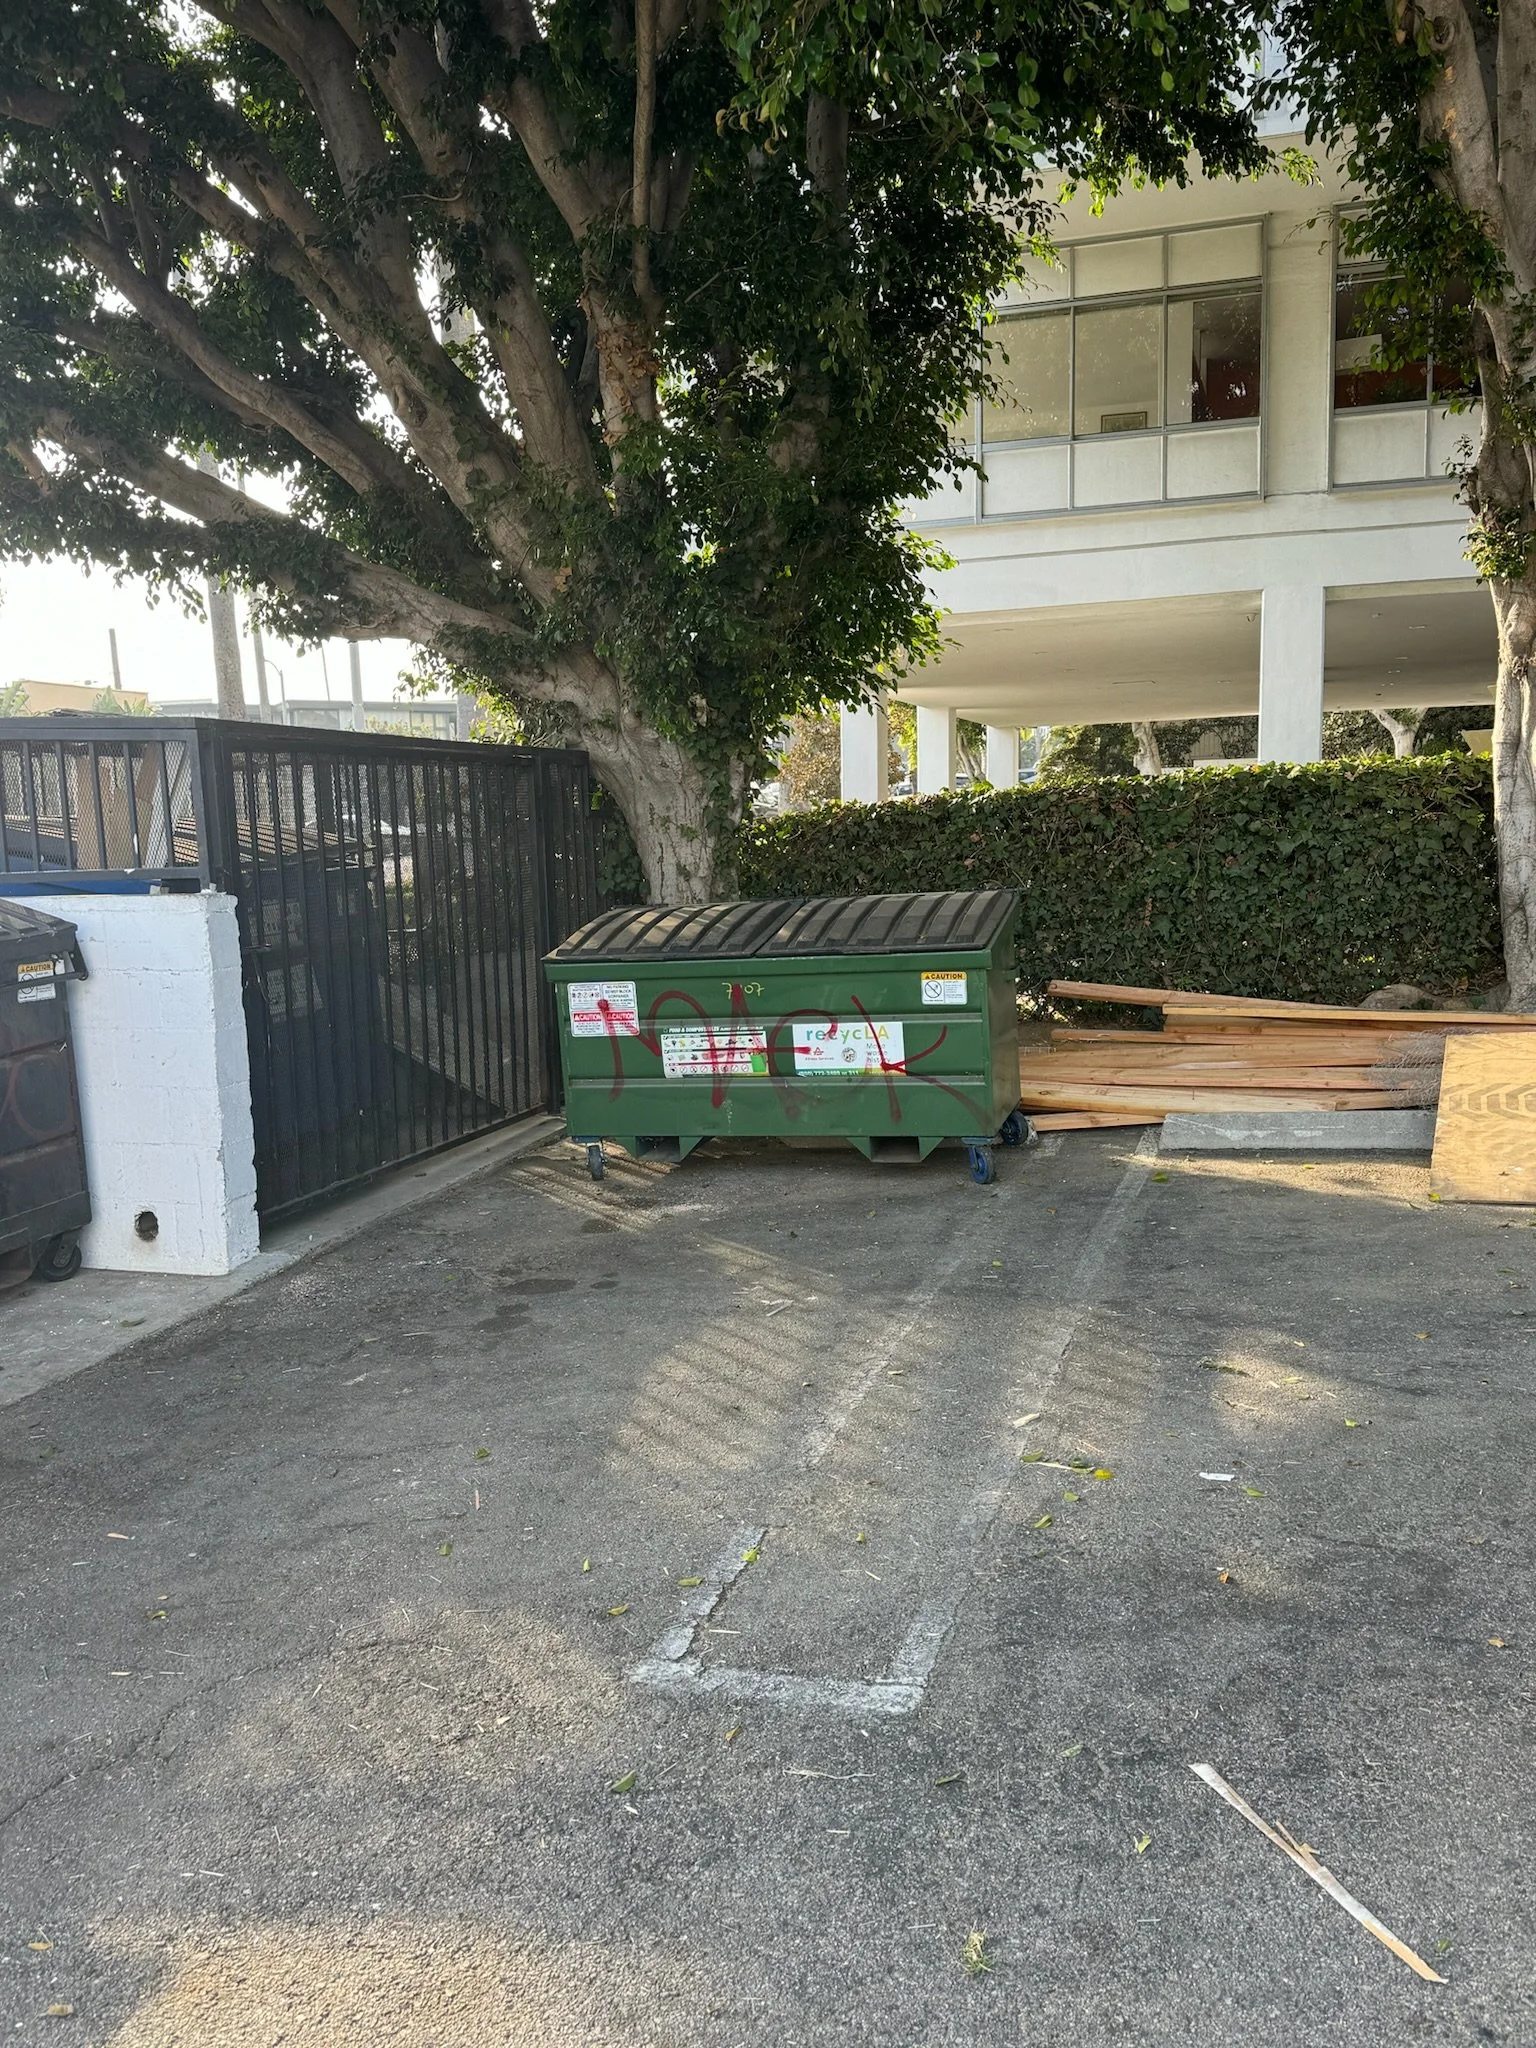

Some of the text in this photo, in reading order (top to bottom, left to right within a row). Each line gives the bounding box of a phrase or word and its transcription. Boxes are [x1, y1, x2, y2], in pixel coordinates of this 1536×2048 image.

[26, 964, 51, 972] CAUTION
[579, 1013, 602, 1021] CAUTION
[612, 1012, 634, 1020] CAUTION
